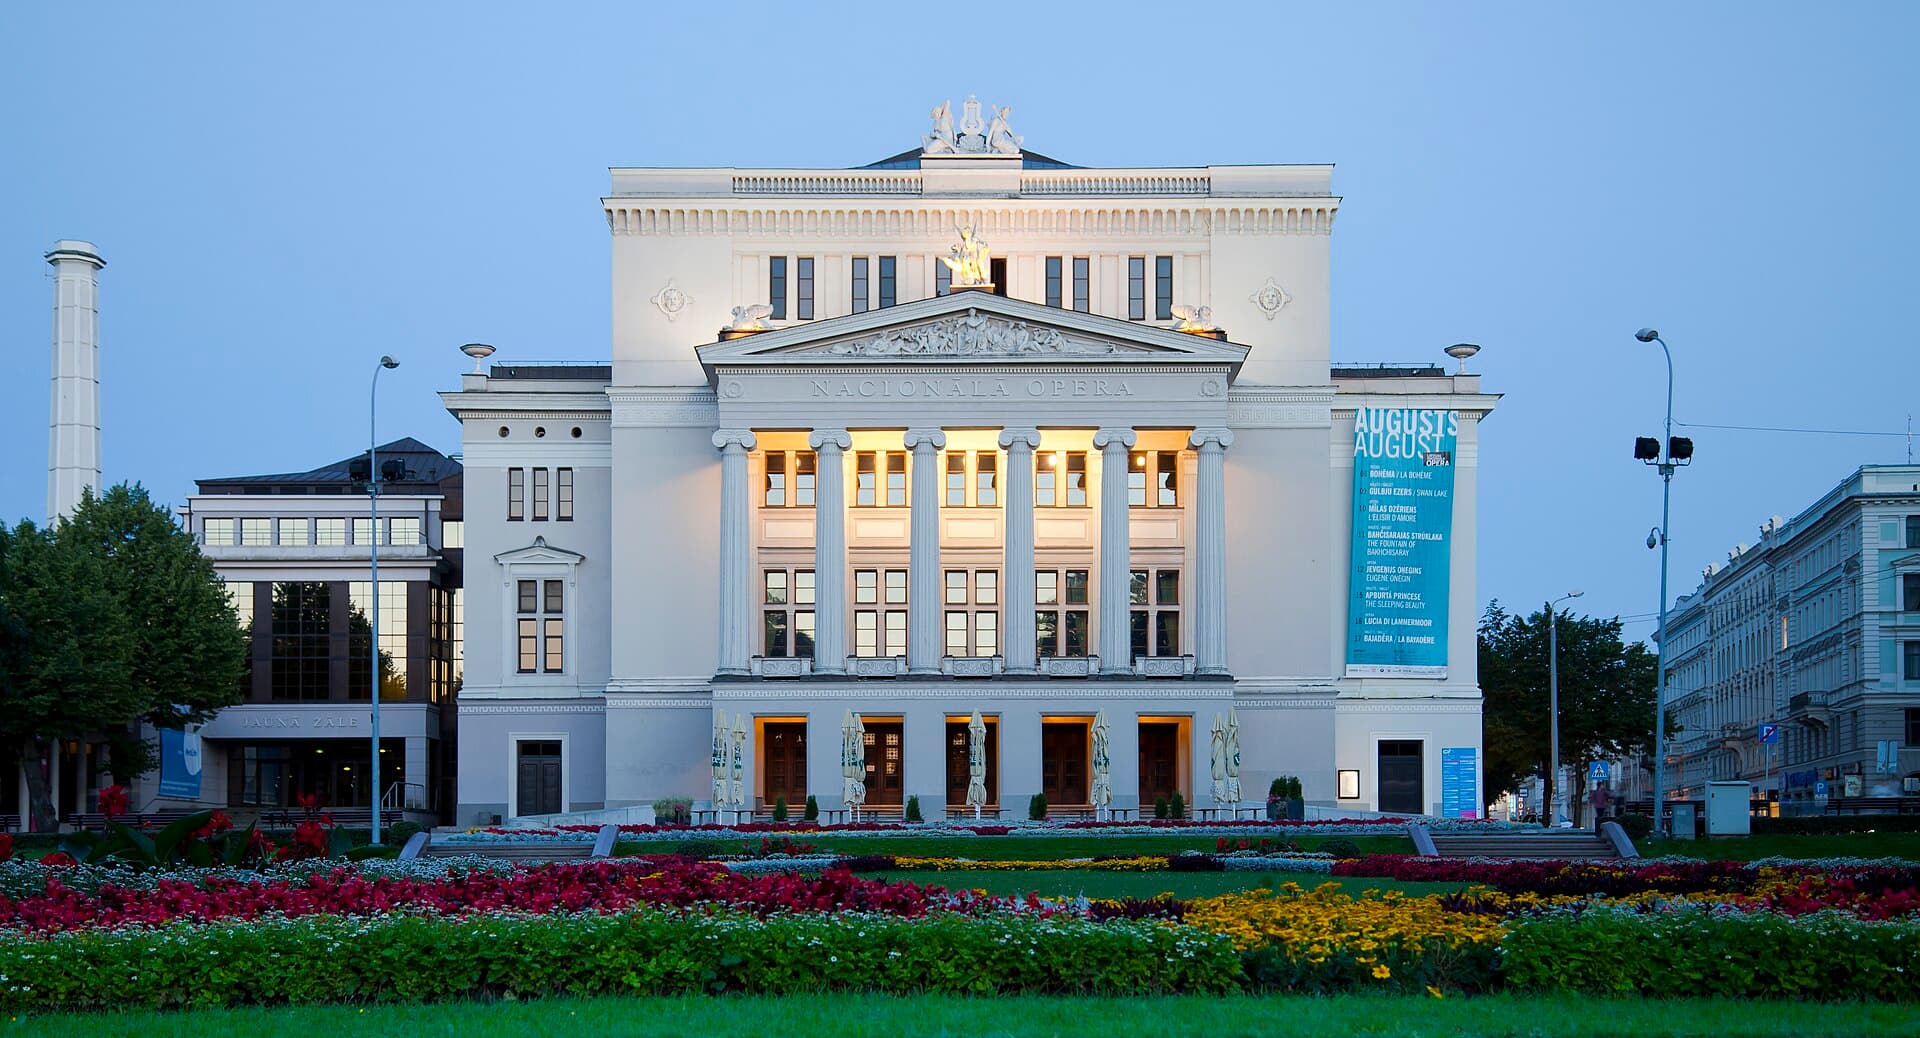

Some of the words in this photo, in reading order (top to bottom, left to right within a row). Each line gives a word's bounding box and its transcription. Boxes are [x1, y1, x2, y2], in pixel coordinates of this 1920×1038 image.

[811, 378, 1009, 397] NACIONĀLĀ
[1027, 379, 1134, 397] OPERA
[1355, 407, 1458, 436] AUGUSTS
[1353, 431, 1445, 459] AUGUST
[1393, 488, 1412, 497] EZERS
[1416, 489, 1433, 498] SWAN
[1433, 489, 1448, 498] LAKE
[1379, 540, 1408, 548] FOUNTAIN
[1393, 592, 1422, 600] PRINCESE
[1365, 600, 1377, 608] THE
[1377, 600, 1404, 609] SLEEPING
[1405, 601, 1426, 609] BEAUTY
[1364, 617, 1382, 625] LUCIA
[1391, 618, 1433, 627] LAMMERMOOR
[1397, 635, 1406, 643] LA
[242, 715, 301, 728] JAUNĀ
[313, 715, 361, 728] ZĀLE
[1763, 726, 1775, 742] P
[1817, 783, 1825, 793] P
